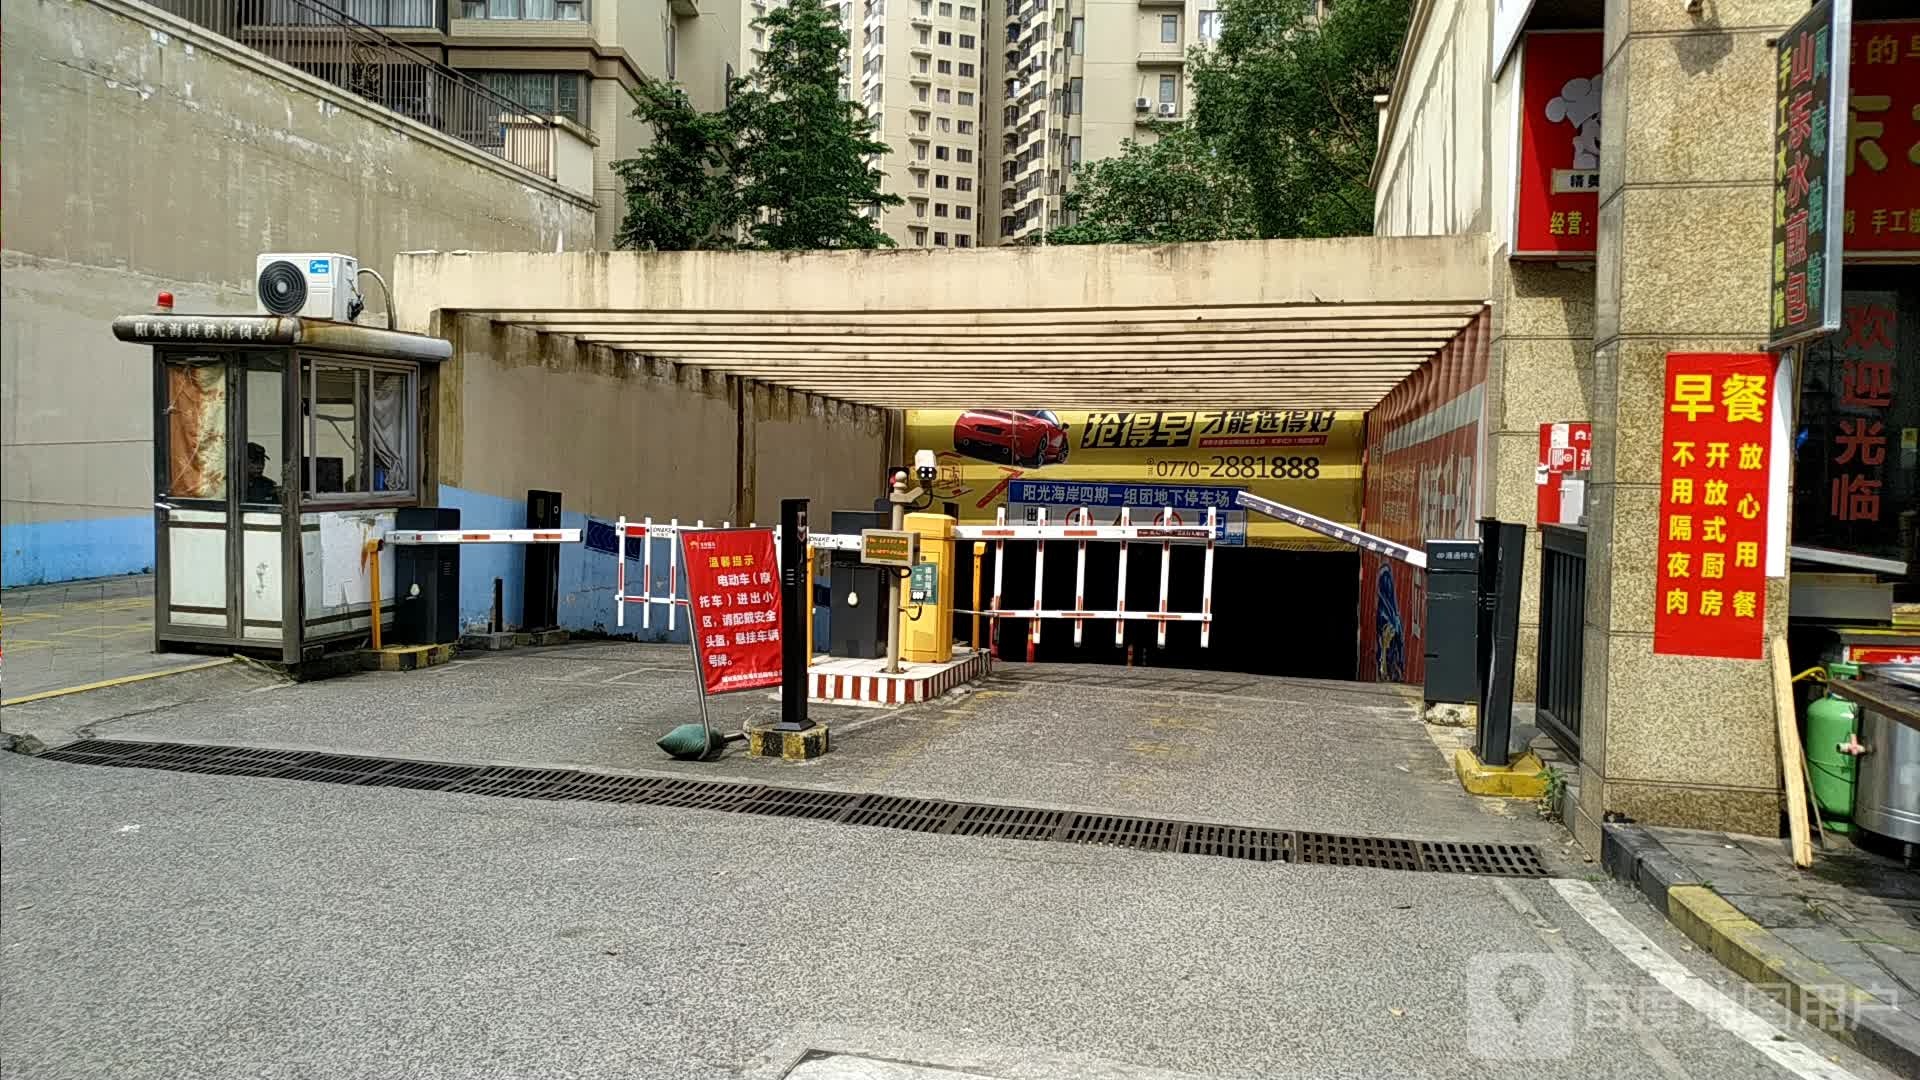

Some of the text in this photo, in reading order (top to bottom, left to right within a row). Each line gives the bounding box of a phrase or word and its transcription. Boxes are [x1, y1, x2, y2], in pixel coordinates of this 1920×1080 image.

[1670, 372, 1768, 424] 早餐
[1831, 304, 1897, 522] 欢迎光临
[1083, 412, 1193, 447] 抢得早
[1200, 410, 1336, 434] 才能选得好
[1156, 456, 1320, 479] 0770-2881888
[1022, 484, 1230, 507] 阳光海岸四期一组团地下停车场
[1665, 441, 1696, 616] 不用隔夜肉
[1699, 442, 1729, 617] 开放式厨房
[1732, 442, 1764, 619] 放心用餐
[708, 555, 755, 568] 温馨提示
